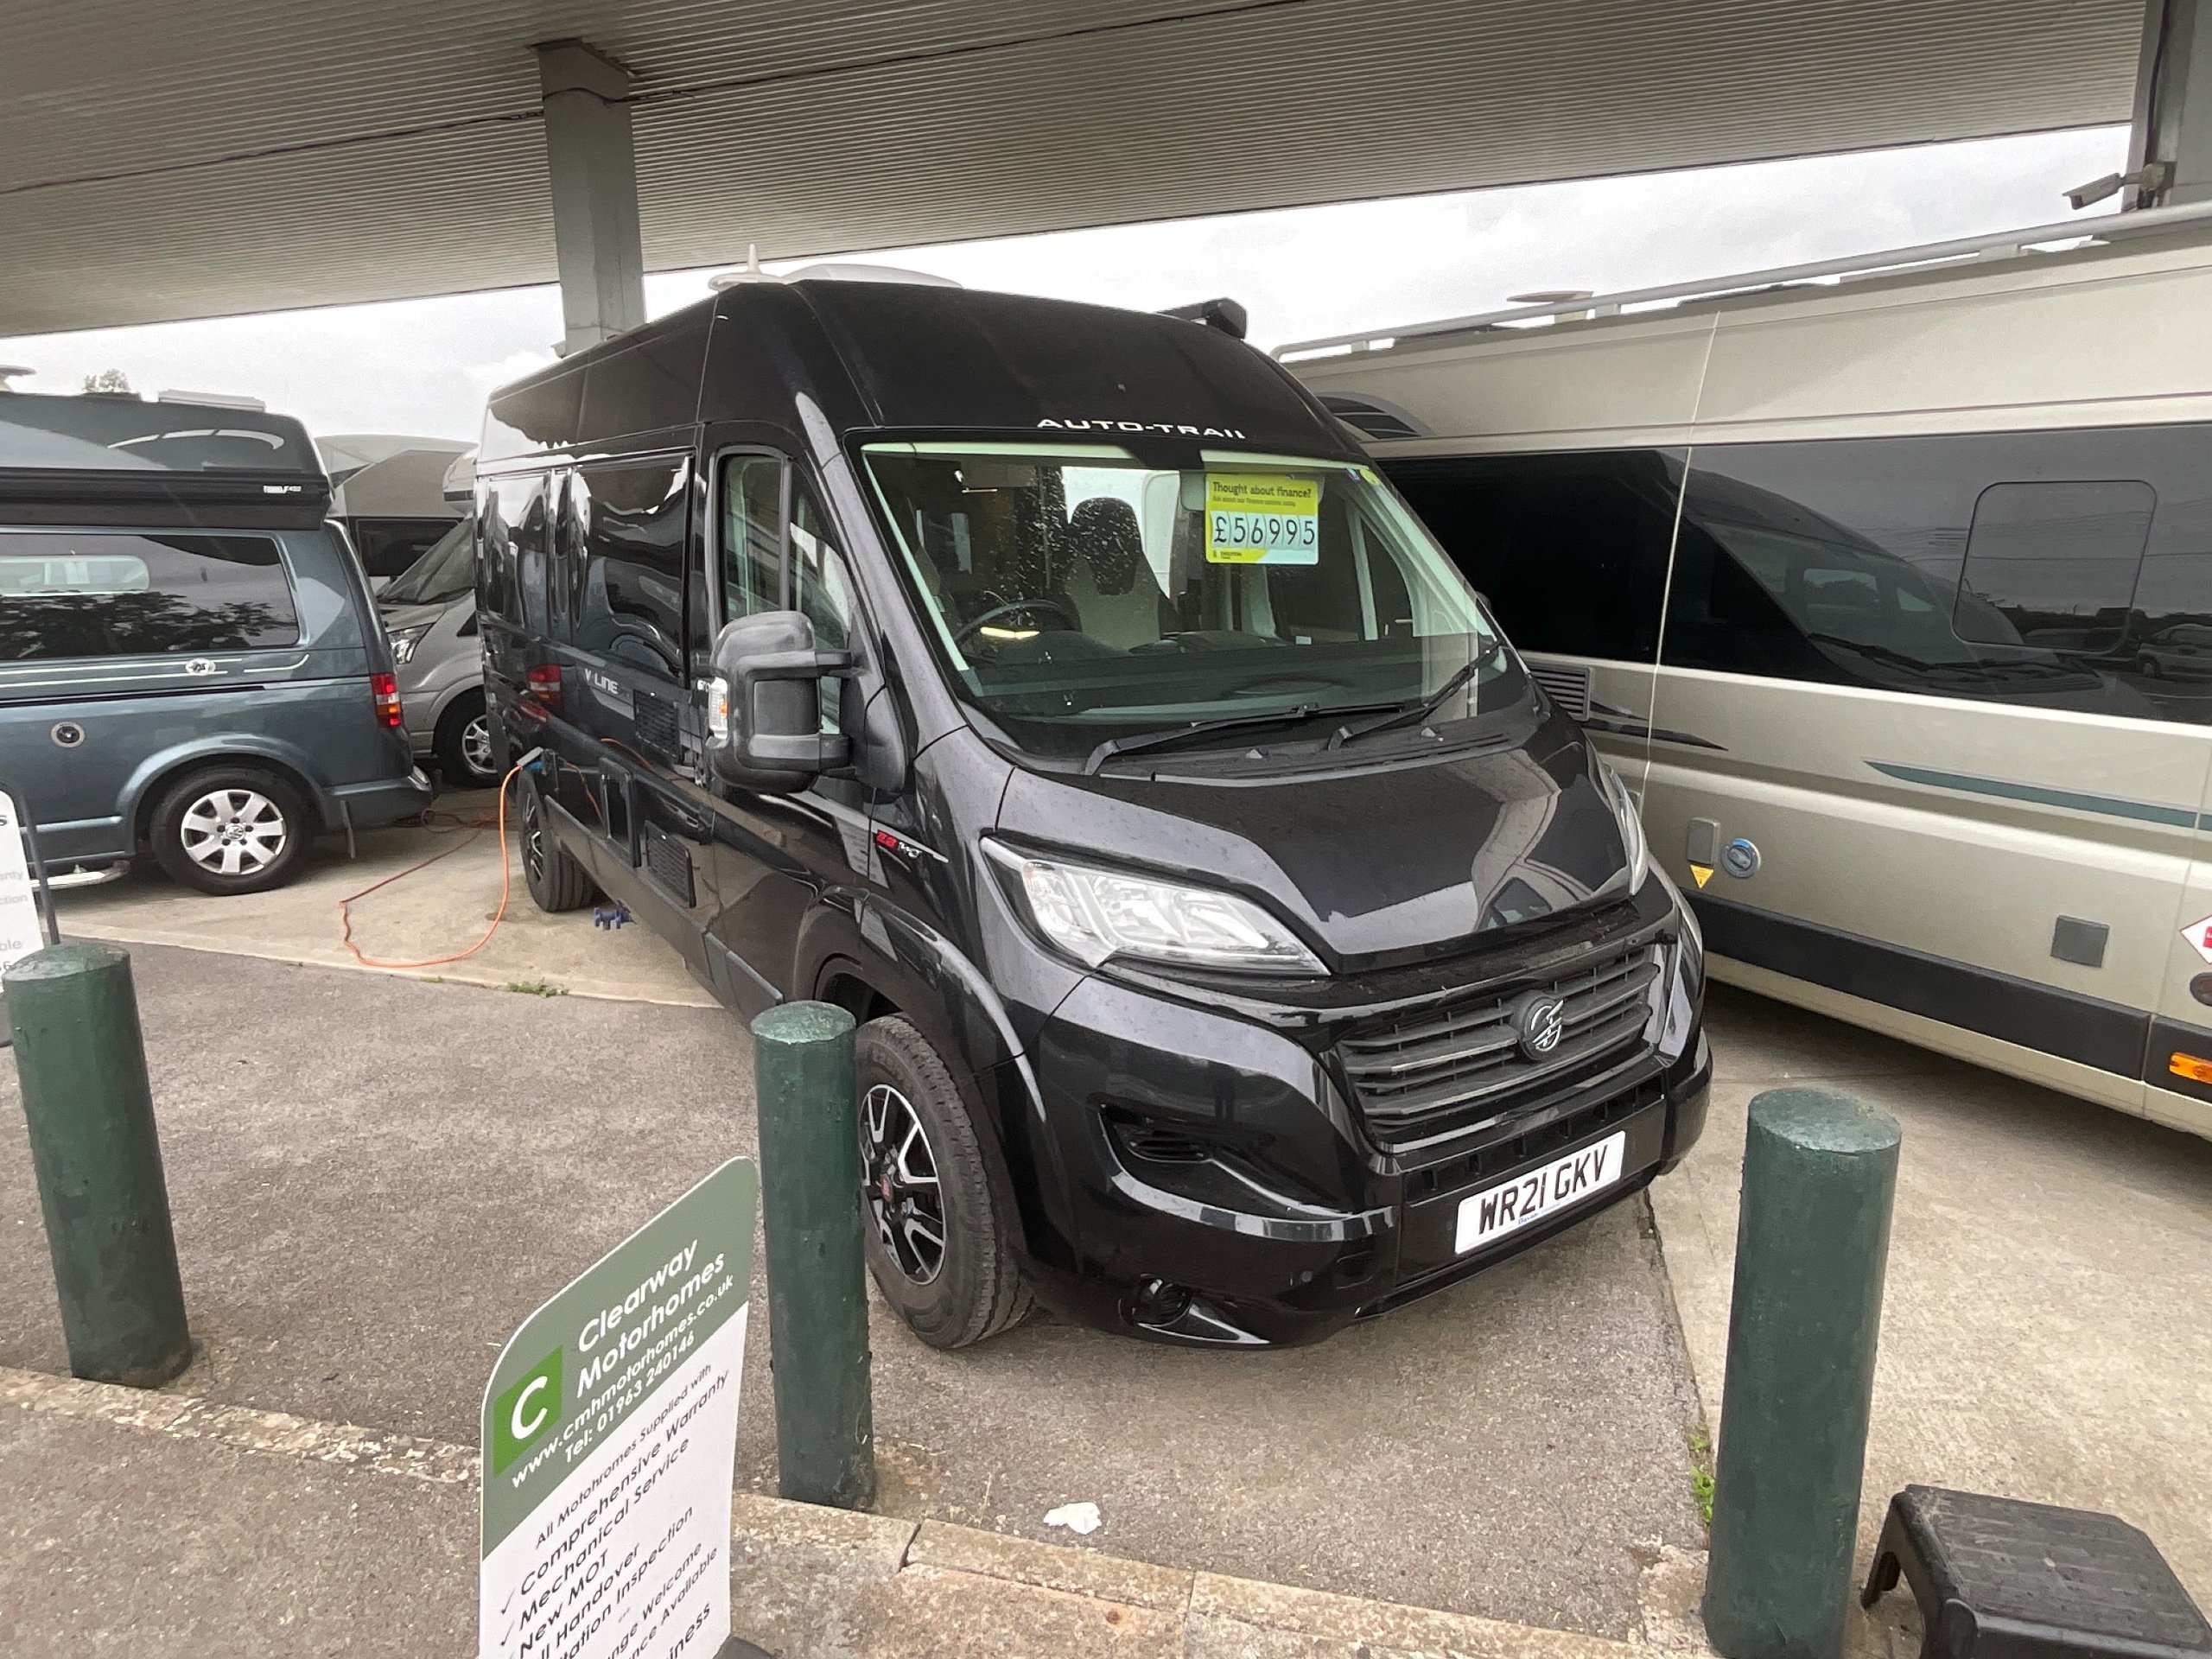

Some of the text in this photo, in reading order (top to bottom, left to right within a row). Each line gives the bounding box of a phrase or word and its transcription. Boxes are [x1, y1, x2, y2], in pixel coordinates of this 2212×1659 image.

[1037, 418, 1246, 439] AUTO-TRAIL
[1212, 481, 1312, 499] Thought about finance?
[1213, 516, 1315, 545] £56995
[1478, 1144, 1608, 1235] WR21 GKV
[576, 1253, 725, 1398] Motorhomes
[578, 1239, 698, 1352] Clearway
[511, 1376, 548, 1440] C
[512, 1274, 734, 1488] www.cmhmotorhomes.co.uk
[565, 1330, 695, 1463] Tel: 01963 240146
[521, 1370, 729, 1595] Comprehensive Warranty
[536, 1525, 554, 1550] All
[639, 1383, 688, 1441] Supplied
[690, 1363, 711, 1389] with
[519, 1438, 689, 1630] Mechanical Service
[616, 1506, 693, 1604] Inspection
[643, 1542, 702, 1621] Welcome
[660, 1547, 718, 1627] Available
[519, 1548, 608, 1659] New MOT
[556, 1541, 640, 1649] Handover
